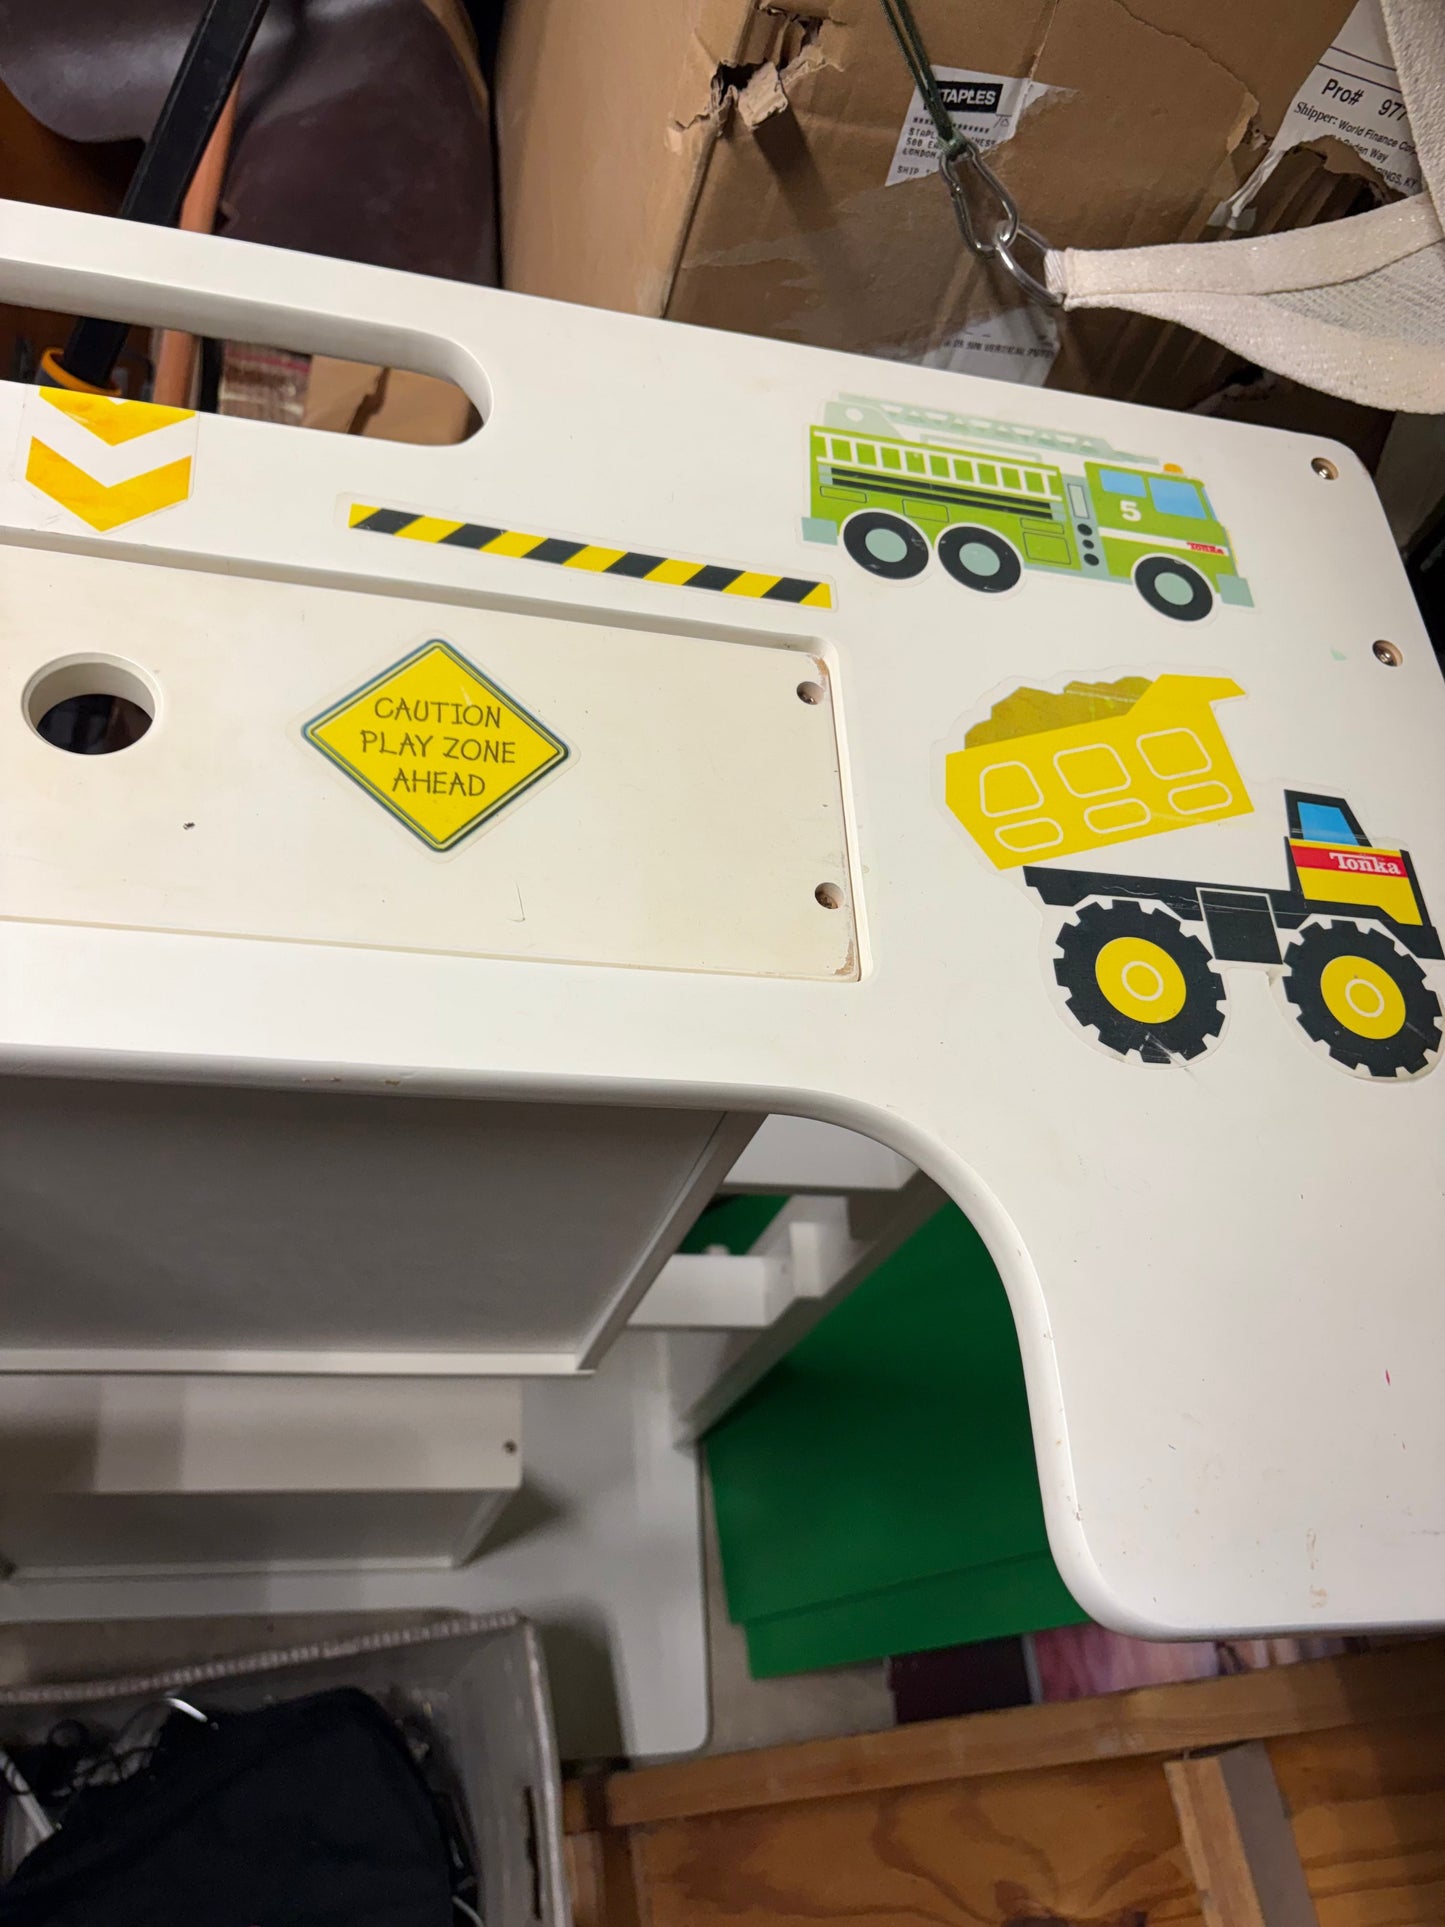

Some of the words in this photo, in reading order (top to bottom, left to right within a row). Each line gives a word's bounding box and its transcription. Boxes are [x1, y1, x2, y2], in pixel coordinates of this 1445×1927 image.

[940, 88, 996, 106] TAPLES
[1321, 78, 1364, 105] Pro#
[1294, 101, 1338, 125] Shipper:
[1338, 119, 1365, 137] World
[1365, 129, 1399, 148] Finance
[1120, 500, 1142, 522] 5
[374, 697, 501, 728] CAUTION
[360, 730, 433, 757] PLAY
[443, 736, 515, 764] ZONE
[392, 768, 486, 797] AHEAD
[1329, 852, 1402, 875] Tonka
